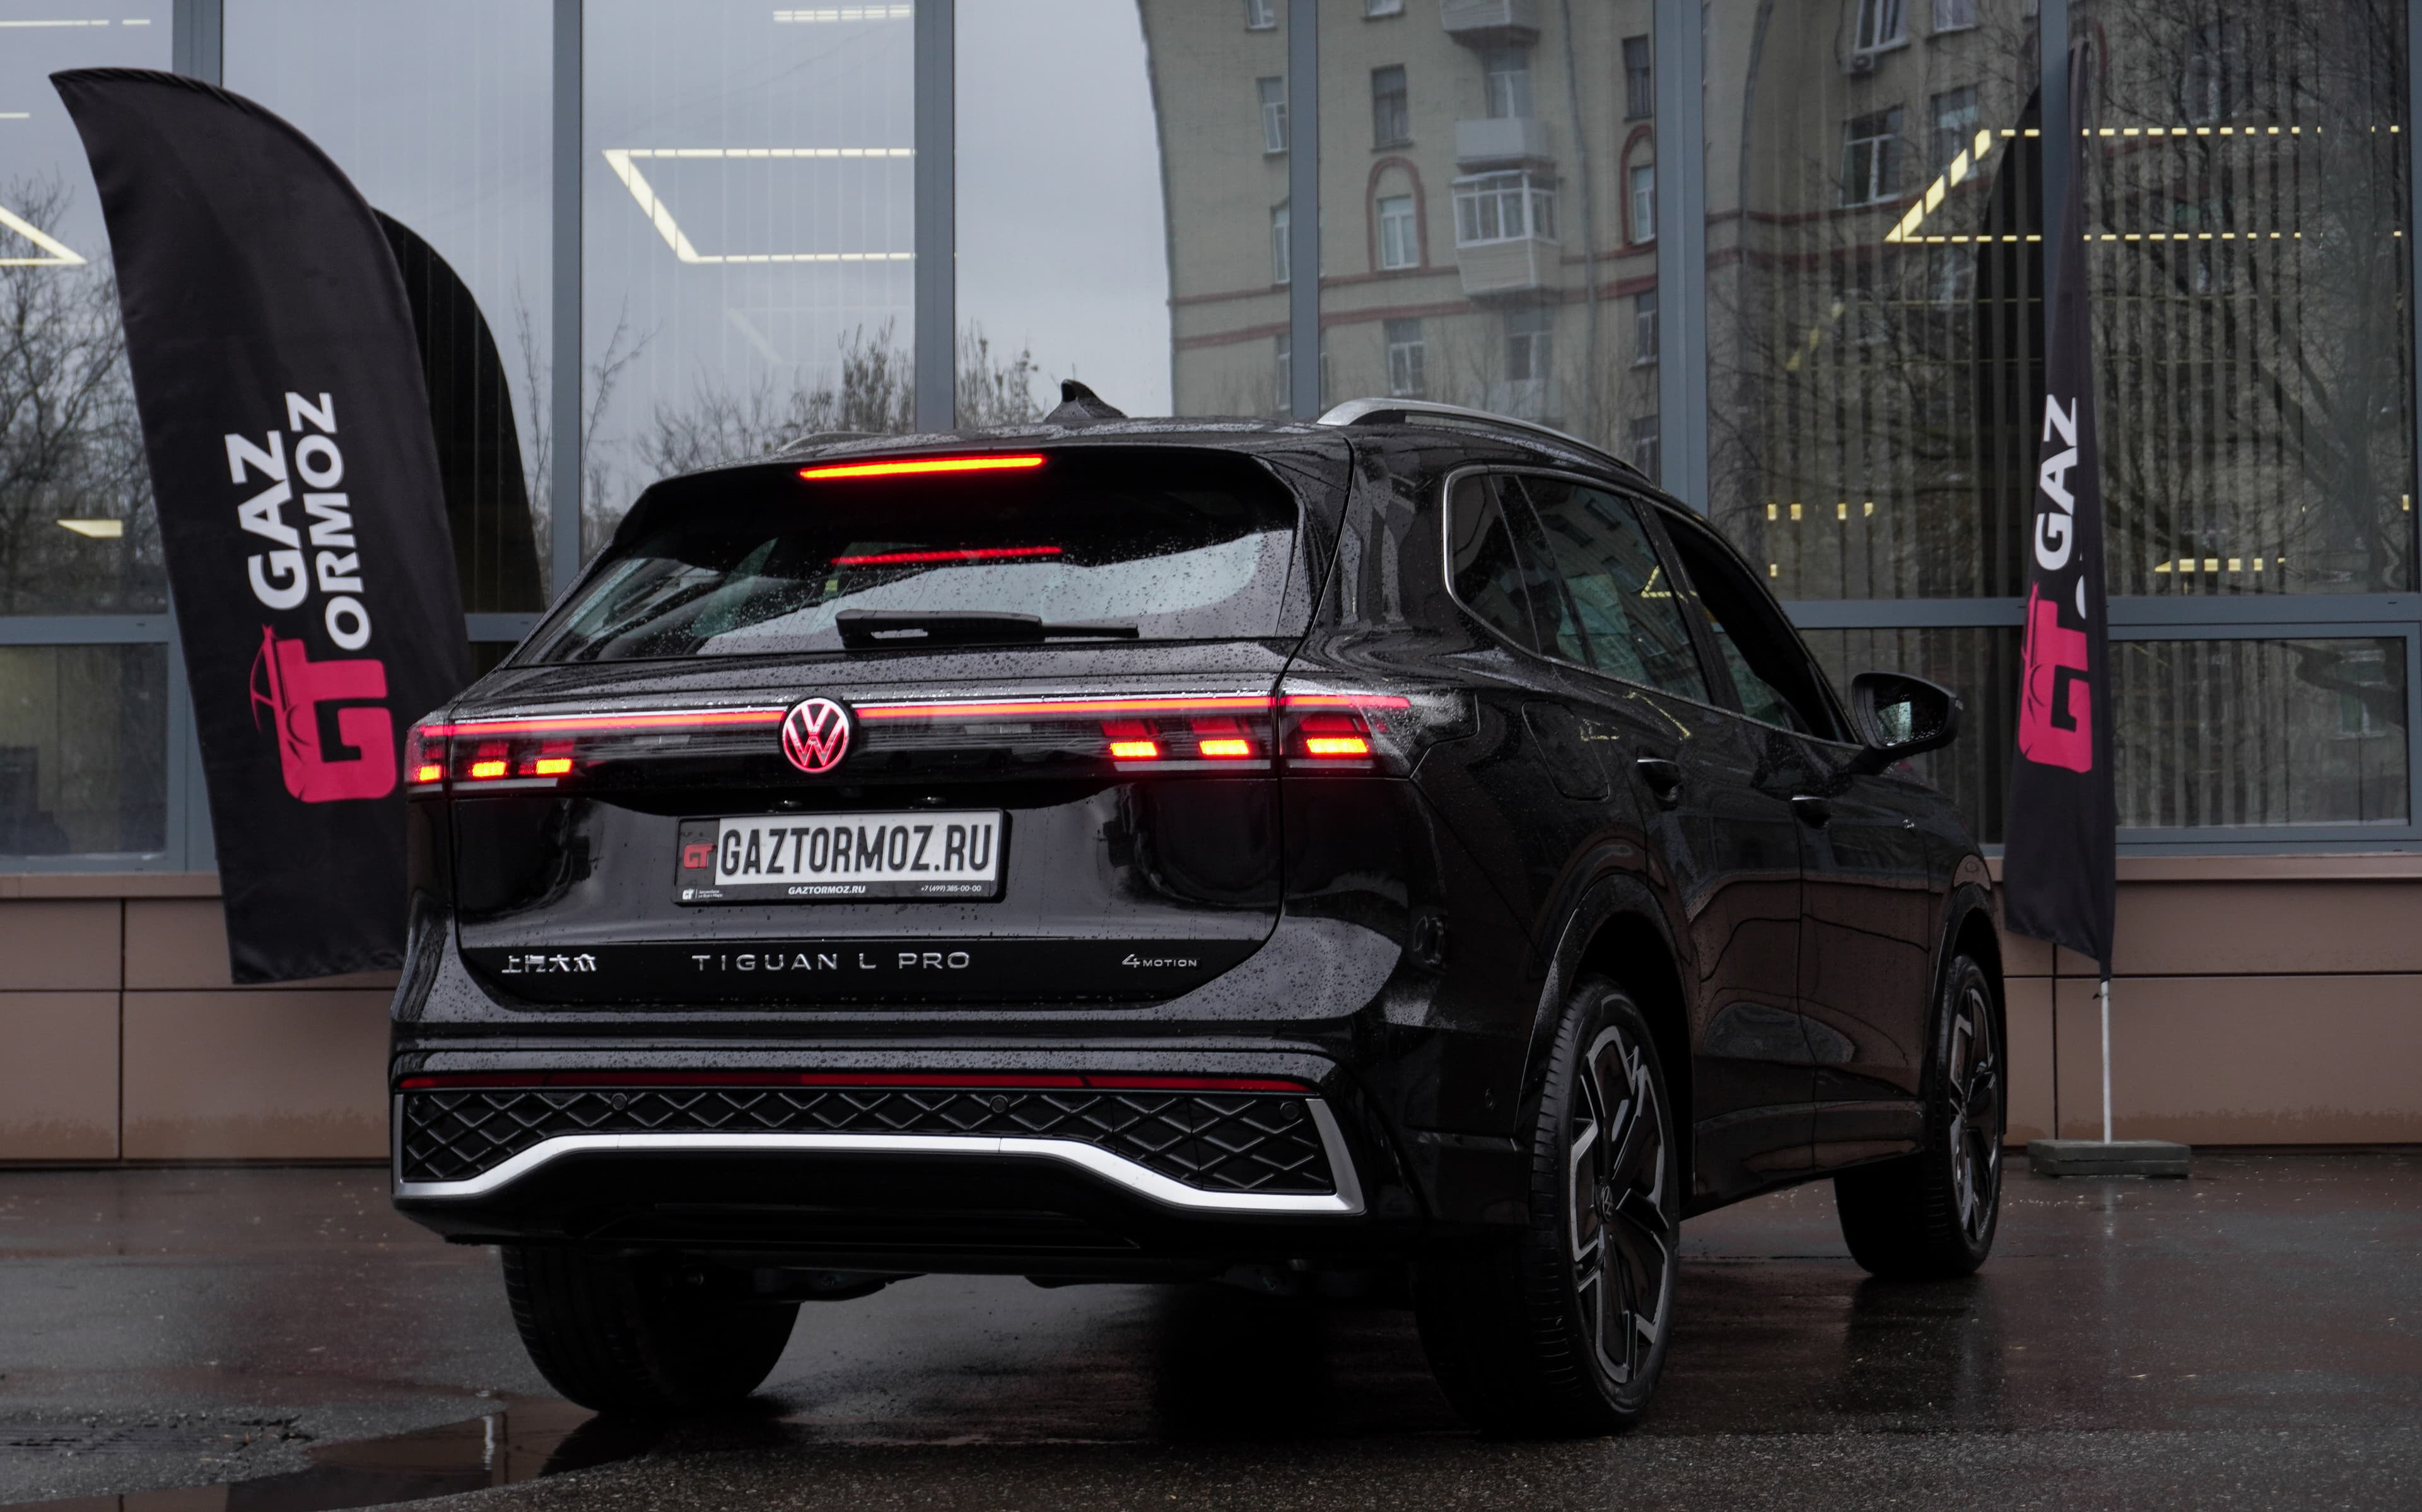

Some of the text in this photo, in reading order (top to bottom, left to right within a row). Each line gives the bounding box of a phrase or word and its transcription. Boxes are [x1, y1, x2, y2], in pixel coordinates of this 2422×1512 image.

[2034, 393, 2078, 571] GAZ
[224, 430, 309, 610] GAZ
[285, 392, 372, 651] ORMOZ
[783, 697, 850, 773] VW
[720, 824, 992, 876] GAZTORMOZ.RU
[788, 885, 866, 895] GAZTORMOZ.RU
[501, 953, 597, 974] 上汽大众
[691, 951, 969, 971] TIGUAN L PRO
